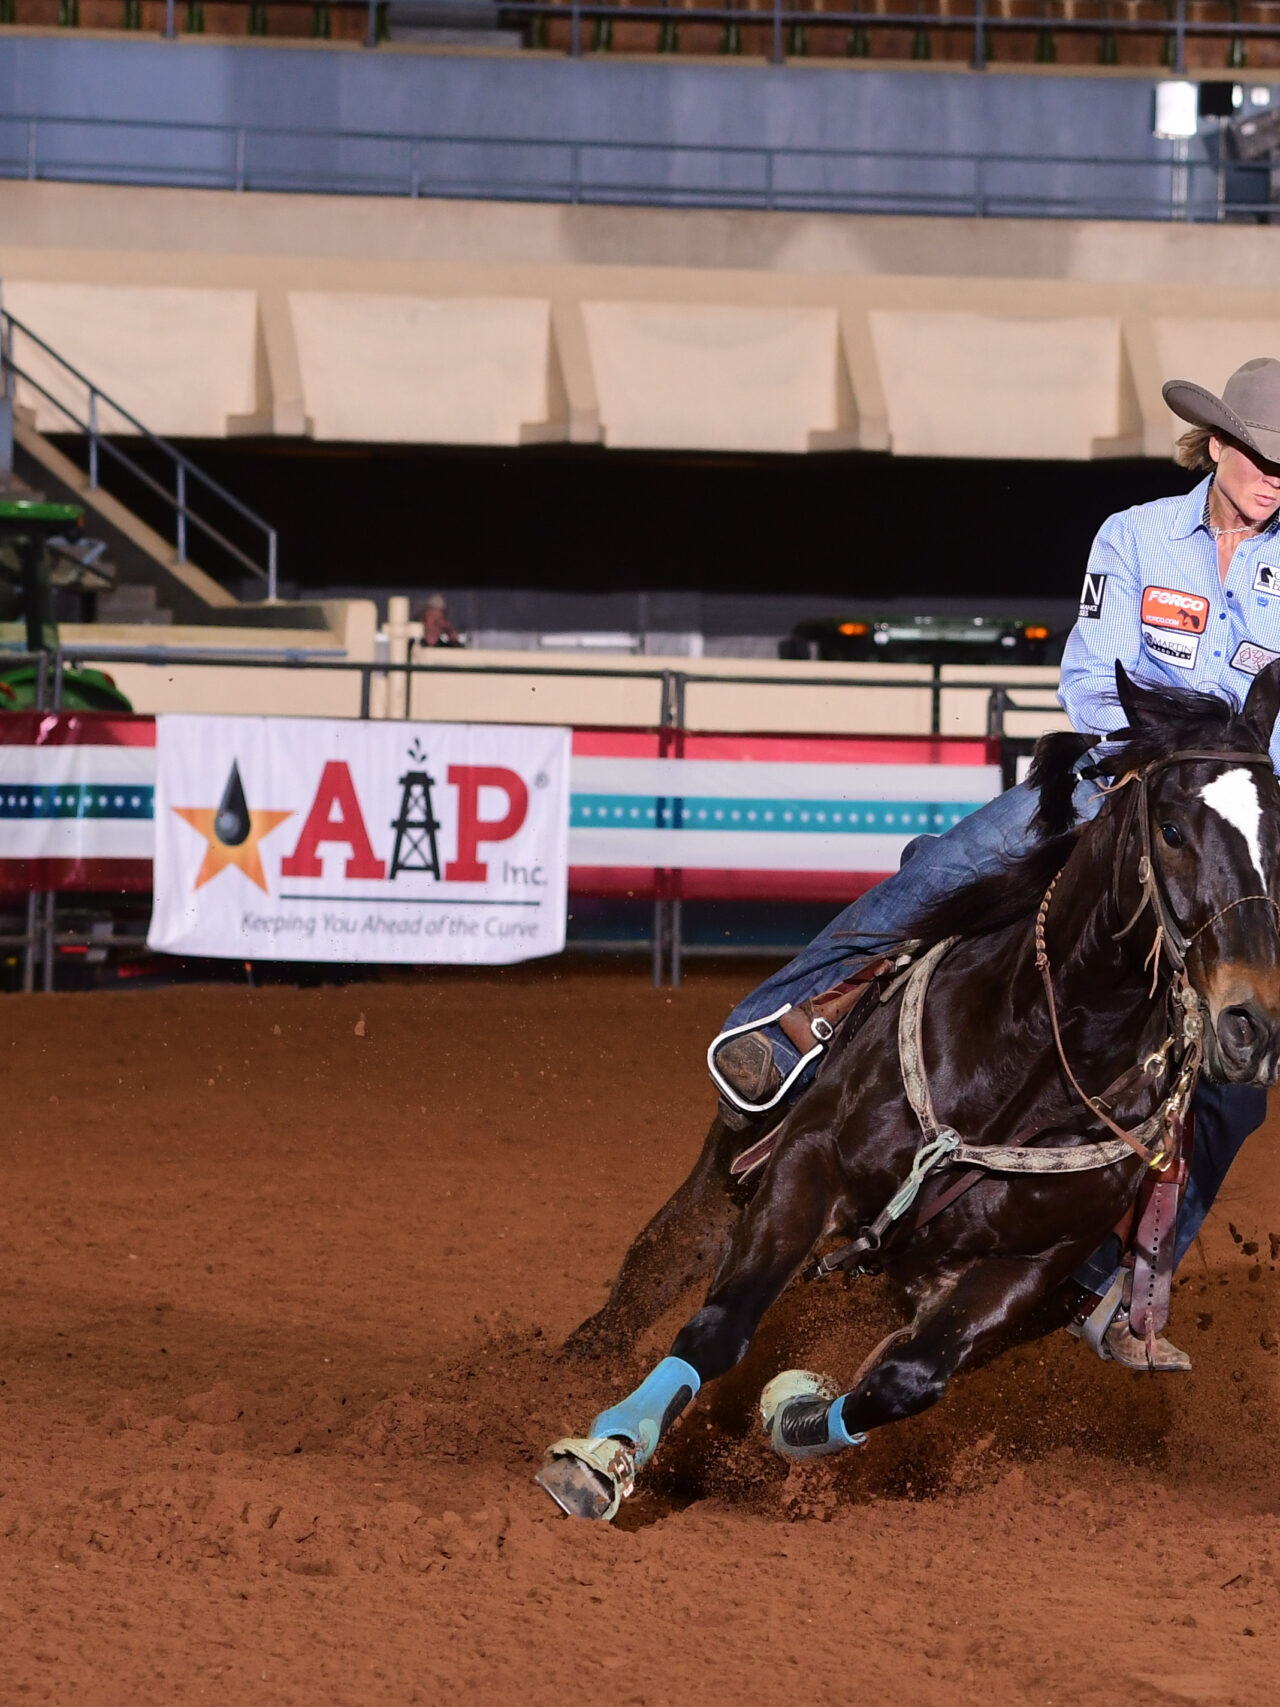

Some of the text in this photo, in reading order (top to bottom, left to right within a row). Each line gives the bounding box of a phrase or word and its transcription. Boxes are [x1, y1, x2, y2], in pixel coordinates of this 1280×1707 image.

[1148, 590, 1204, 611] FORCO
[1152, 637, 1194, 654] MARTIN
[501, 861, 548, 887] Inc.
[240, 912, 540, 939] Keeping You Ahead of the Curve
